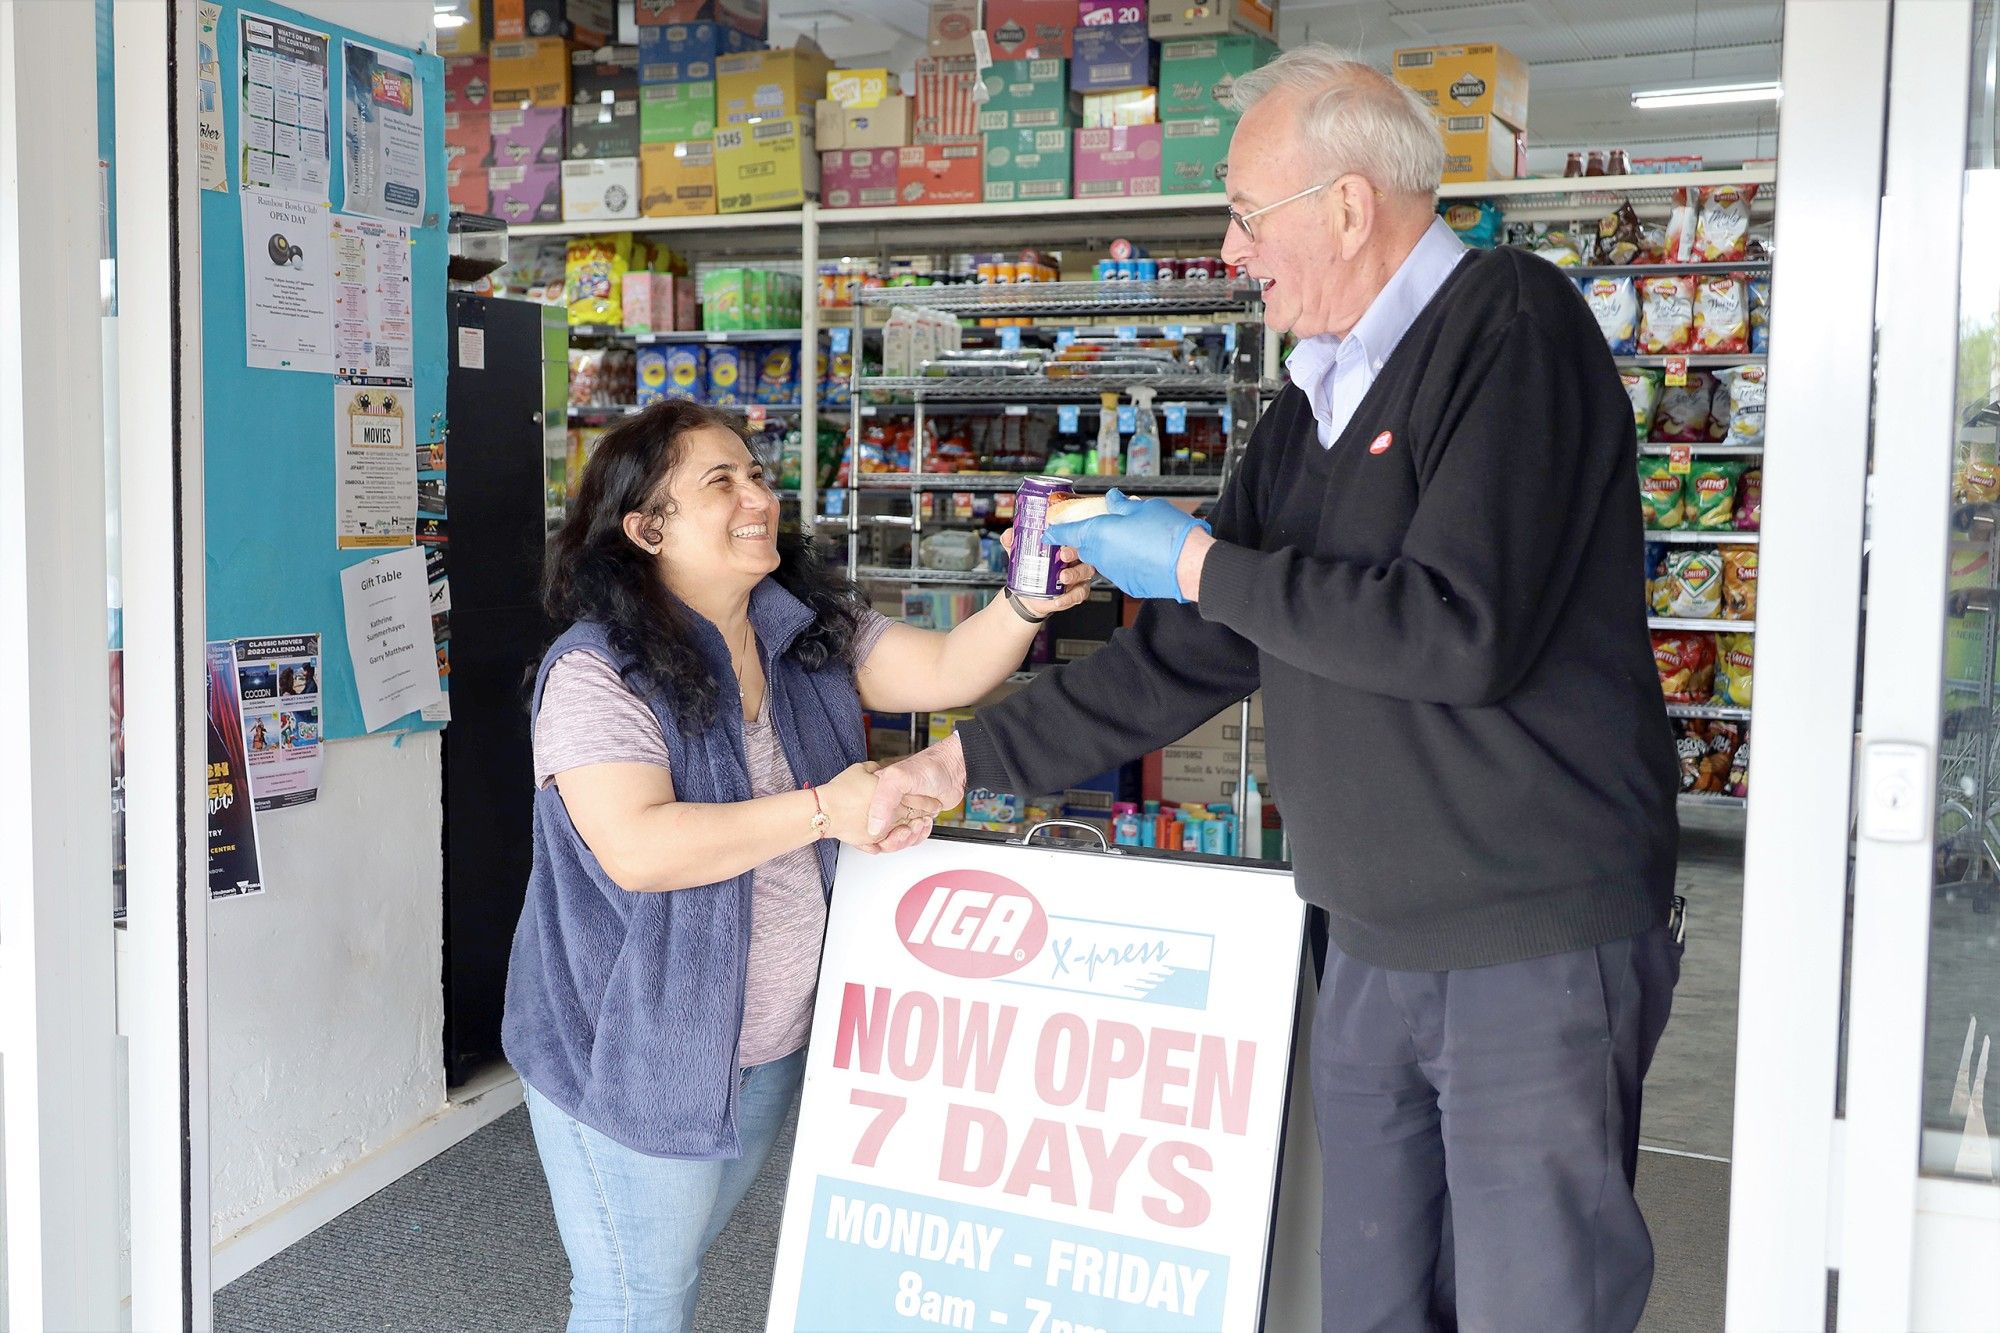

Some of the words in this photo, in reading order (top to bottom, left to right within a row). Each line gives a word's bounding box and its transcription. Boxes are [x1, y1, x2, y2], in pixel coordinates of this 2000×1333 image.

[1118, 7, 1139, 23] 20
[269, 210, 289, 222] OPEN
[291, 214, 306, 225] DAY
[364, 427, 391, 444] MOVIES
[361, 577, 375, 591] Gift
[376, 570, 402, 585] Table
[370, 615, 393, 629] Kathrine
[367, 623, 406, 642] Summerhayes
[247, 648, 265, 656] 2023
[266, 645, 306, 655] CALENDAR
[249, 639, 277, 648] CLASSIC
[278, 638, 303, 646] MOVIES
[382, 640, 388, 648] &
[369, 654, 385, 665] Garry
[384, 643, 414, 658] Matthews
[209, 829, 223, 838] TRY
[210, 844, 236, 854] CENTRE
[907, 886, 1034, 957] IGA
[1051, 936, 1171, 983] X-press
[833, 982, 1019, 1096] NOW
[1034, 1012, 1257, 1136] OPEN
[848, 1088, 907, 1169] 7
[938, 1103, 1214, 1228] DAYS
[825, 1194, 1004, 1273] MONDAY
[1045, 1239, 1211, 1318] FRIDAY
[895, 1270, 976, 1331] 8am
